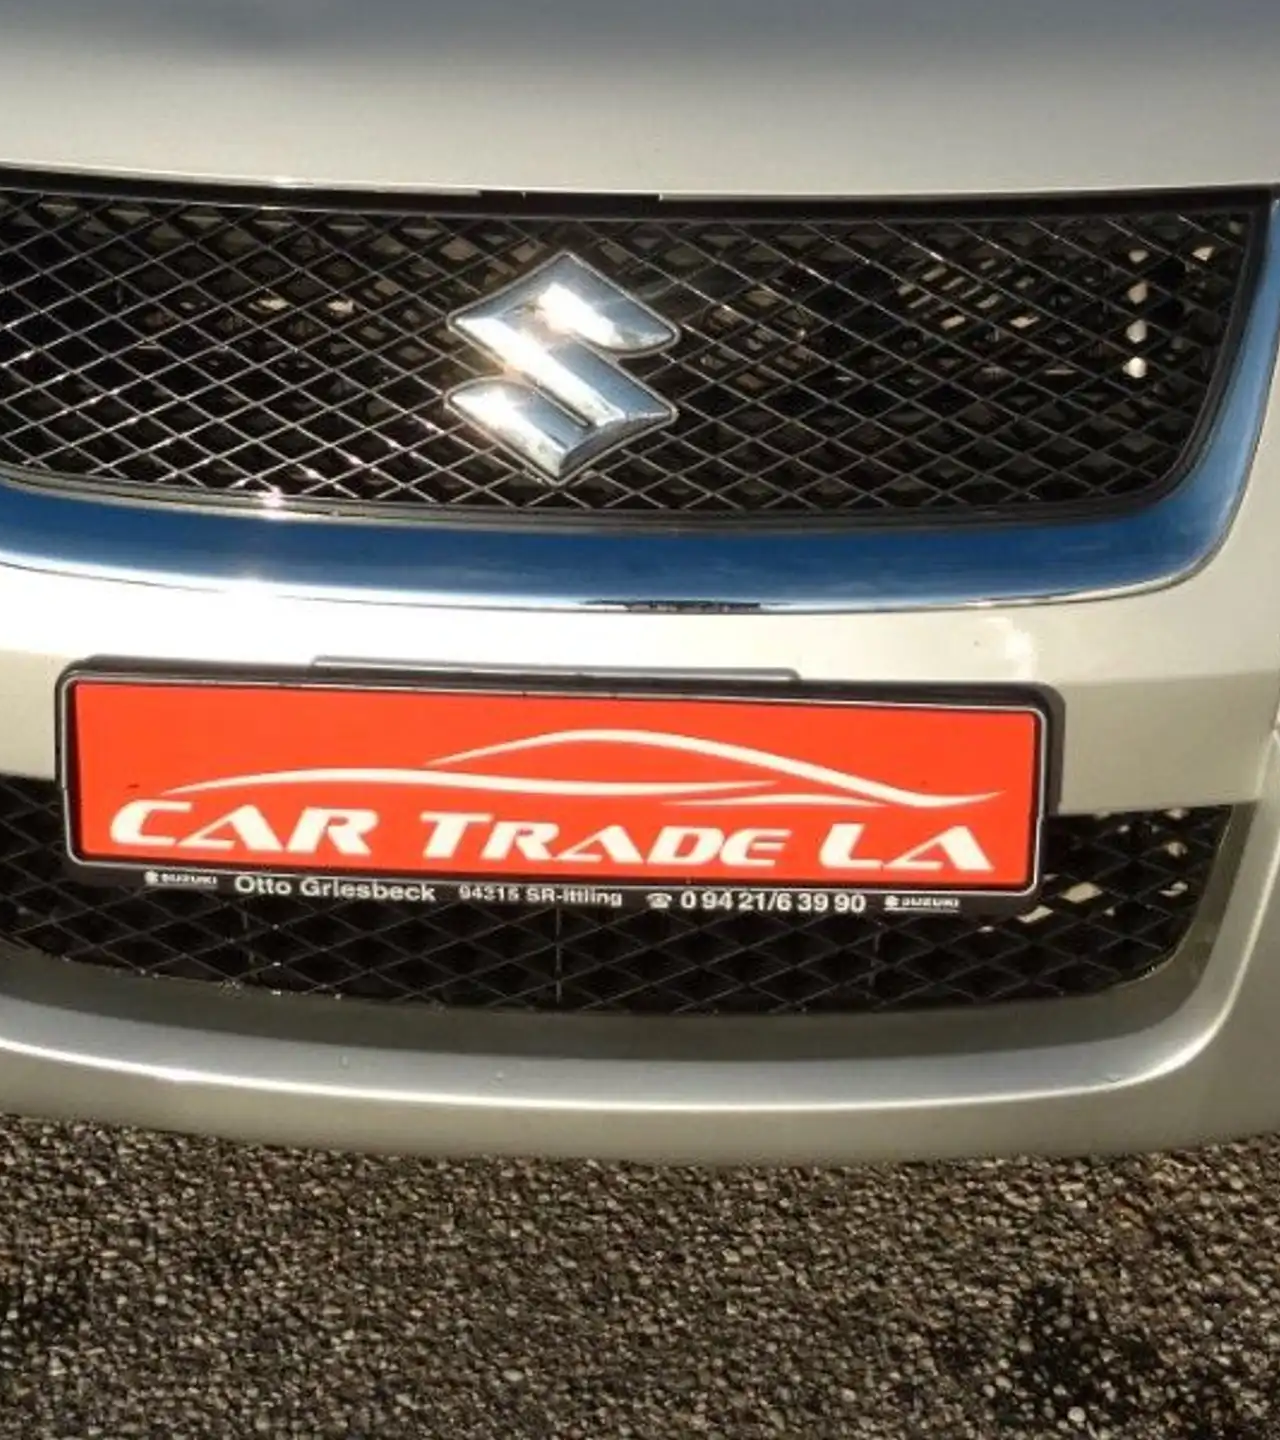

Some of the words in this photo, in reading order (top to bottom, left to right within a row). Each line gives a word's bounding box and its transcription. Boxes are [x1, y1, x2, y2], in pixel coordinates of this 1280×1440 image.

[109, 799, 379, 856] CAR
[419, 811, 793, 867] TRADE
[819, 822, 995, 873] LA
[234, 875, 293, 896] Otto
[299, 878, 437, 902] Griesbeck
